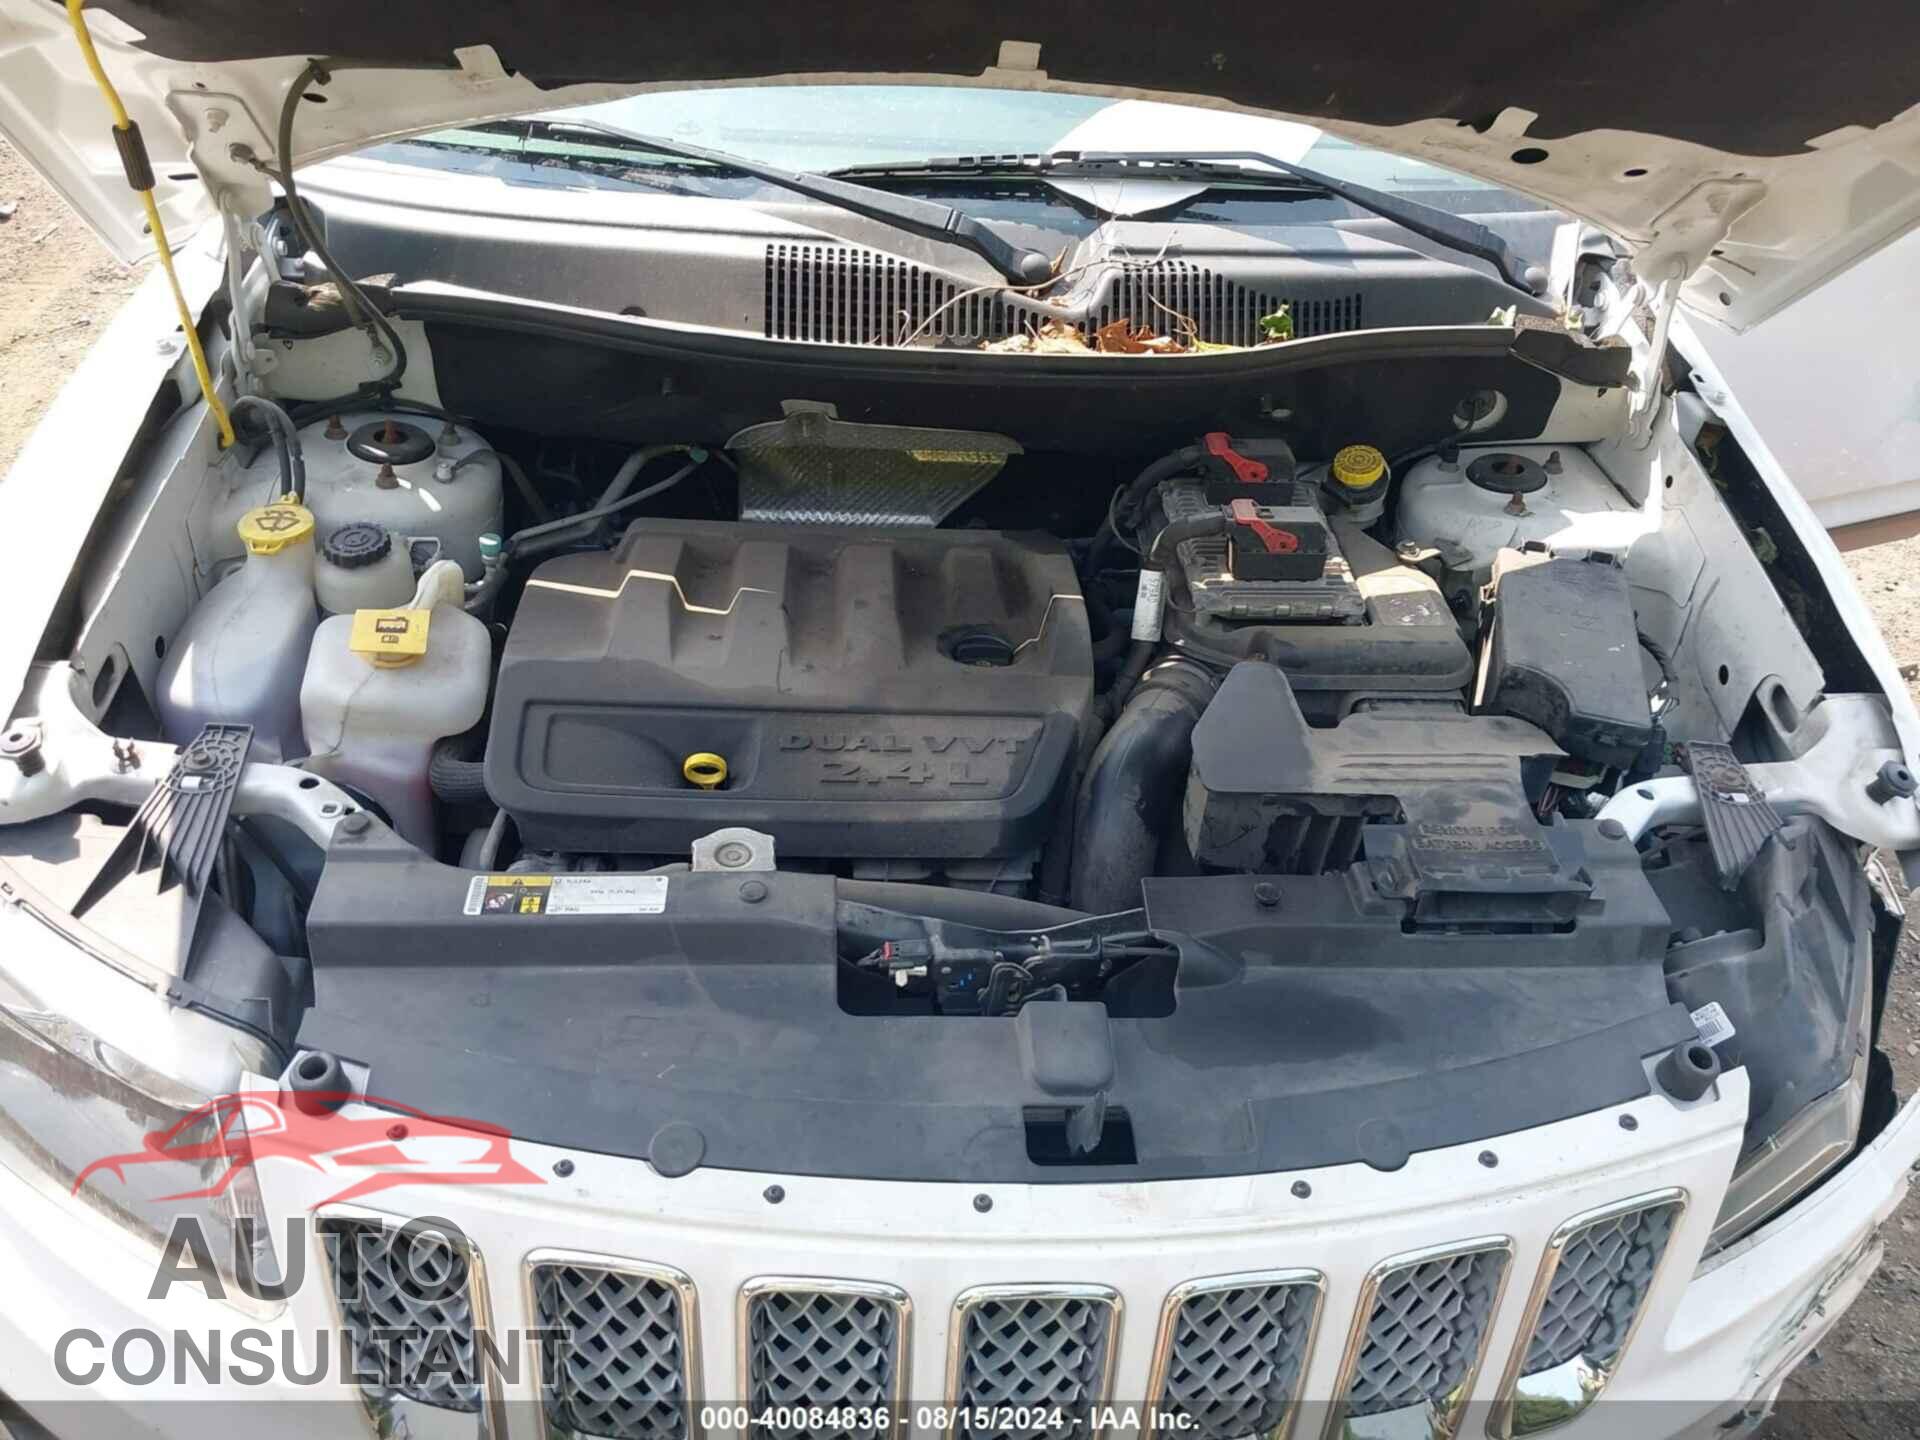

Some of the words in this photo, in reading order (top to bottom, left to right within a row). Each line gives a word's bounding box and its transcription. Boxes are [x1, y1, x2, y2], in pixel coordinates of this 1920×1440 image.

[779, 735, 913, 752] DUAL
[921, 736, 1027, 754] VVT
[818, 762, 989, 786] 2.4L
